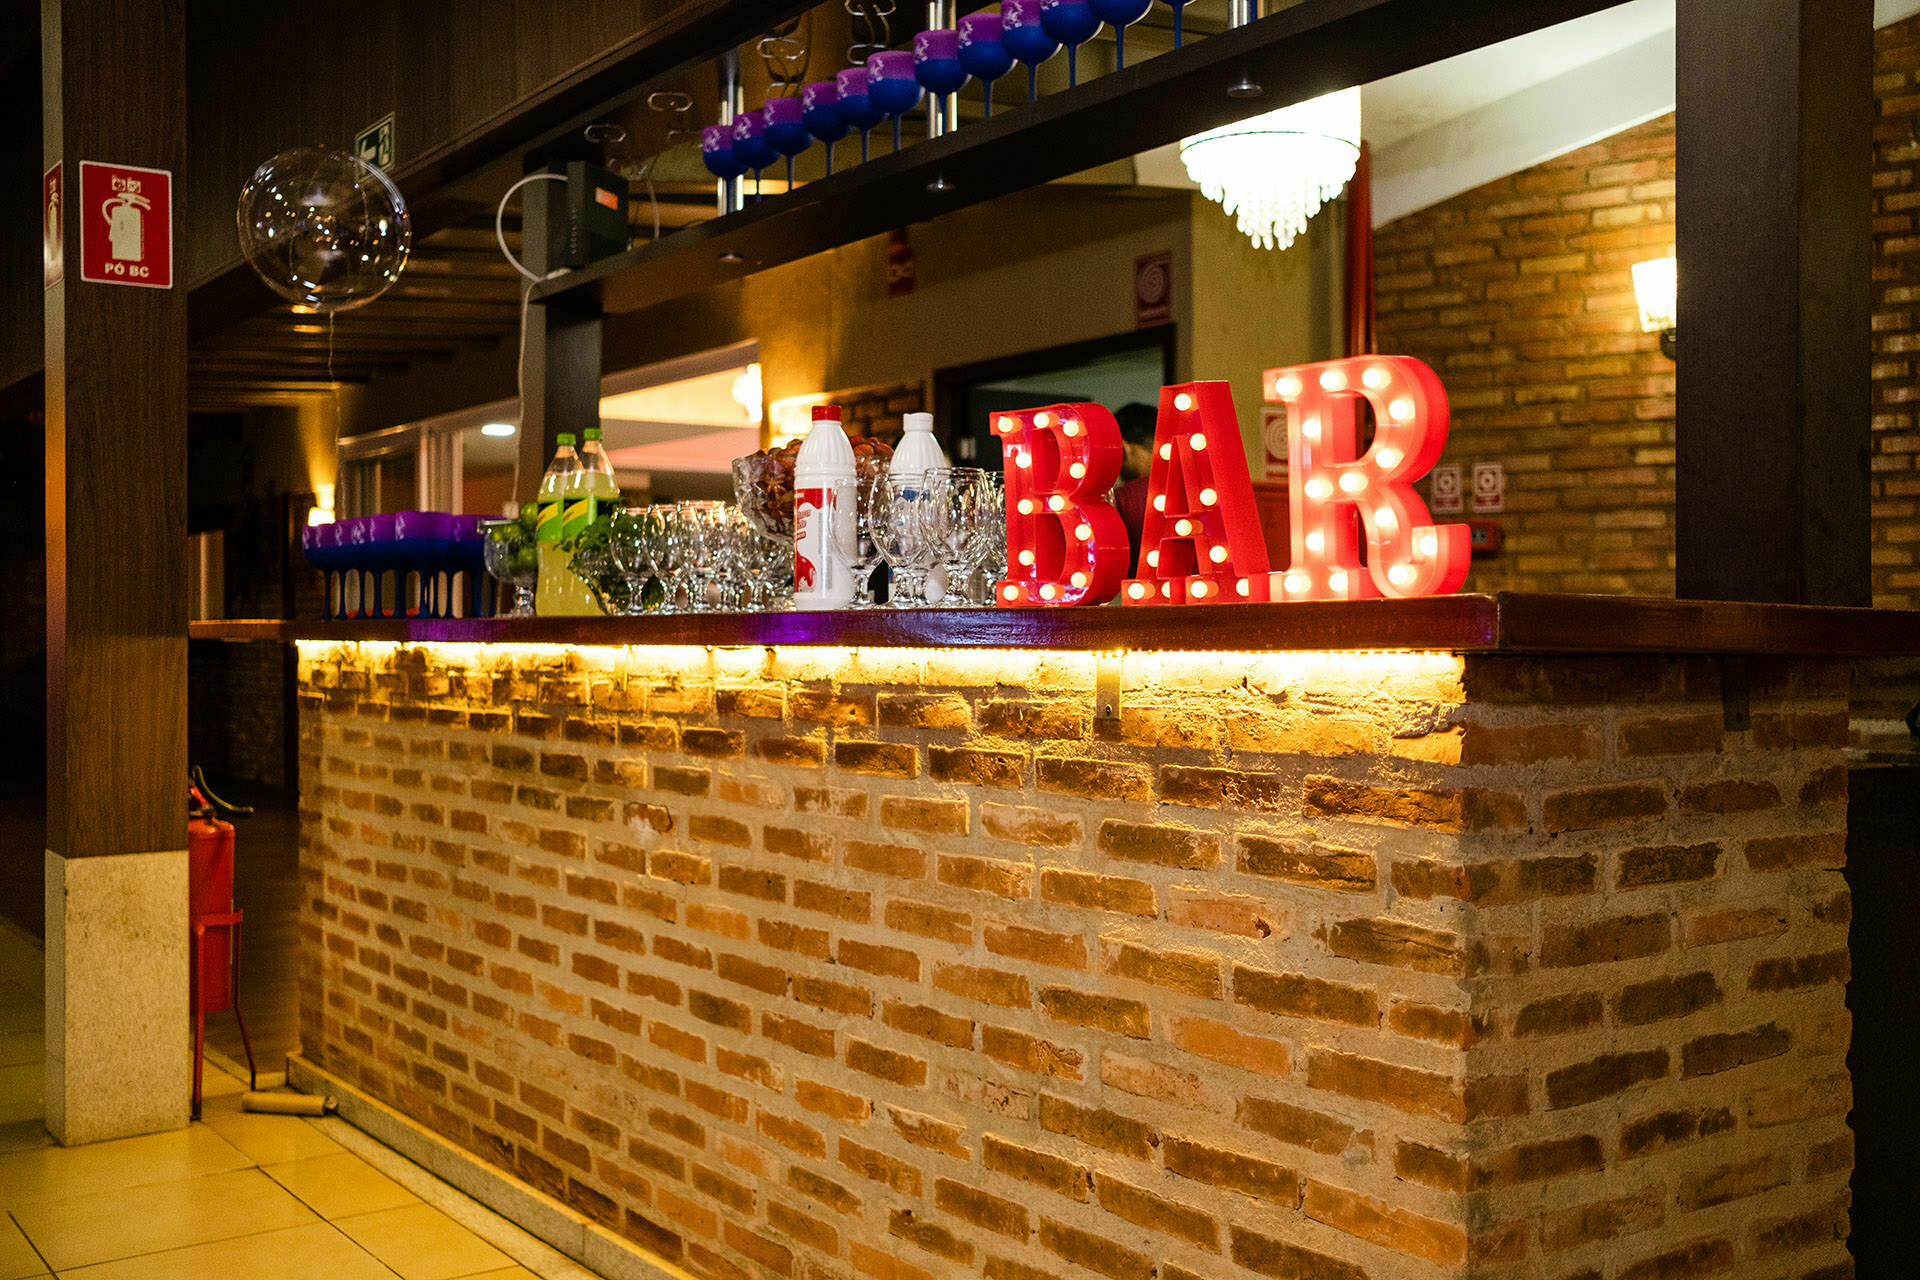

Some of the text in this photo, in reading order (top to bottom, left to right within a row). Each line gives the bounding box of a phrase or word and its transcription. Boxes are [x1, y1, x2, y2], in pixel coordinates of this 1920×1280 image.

[104, 262, 150, 278] PÓ BC
[989, 355, 1473, 607] BAR
